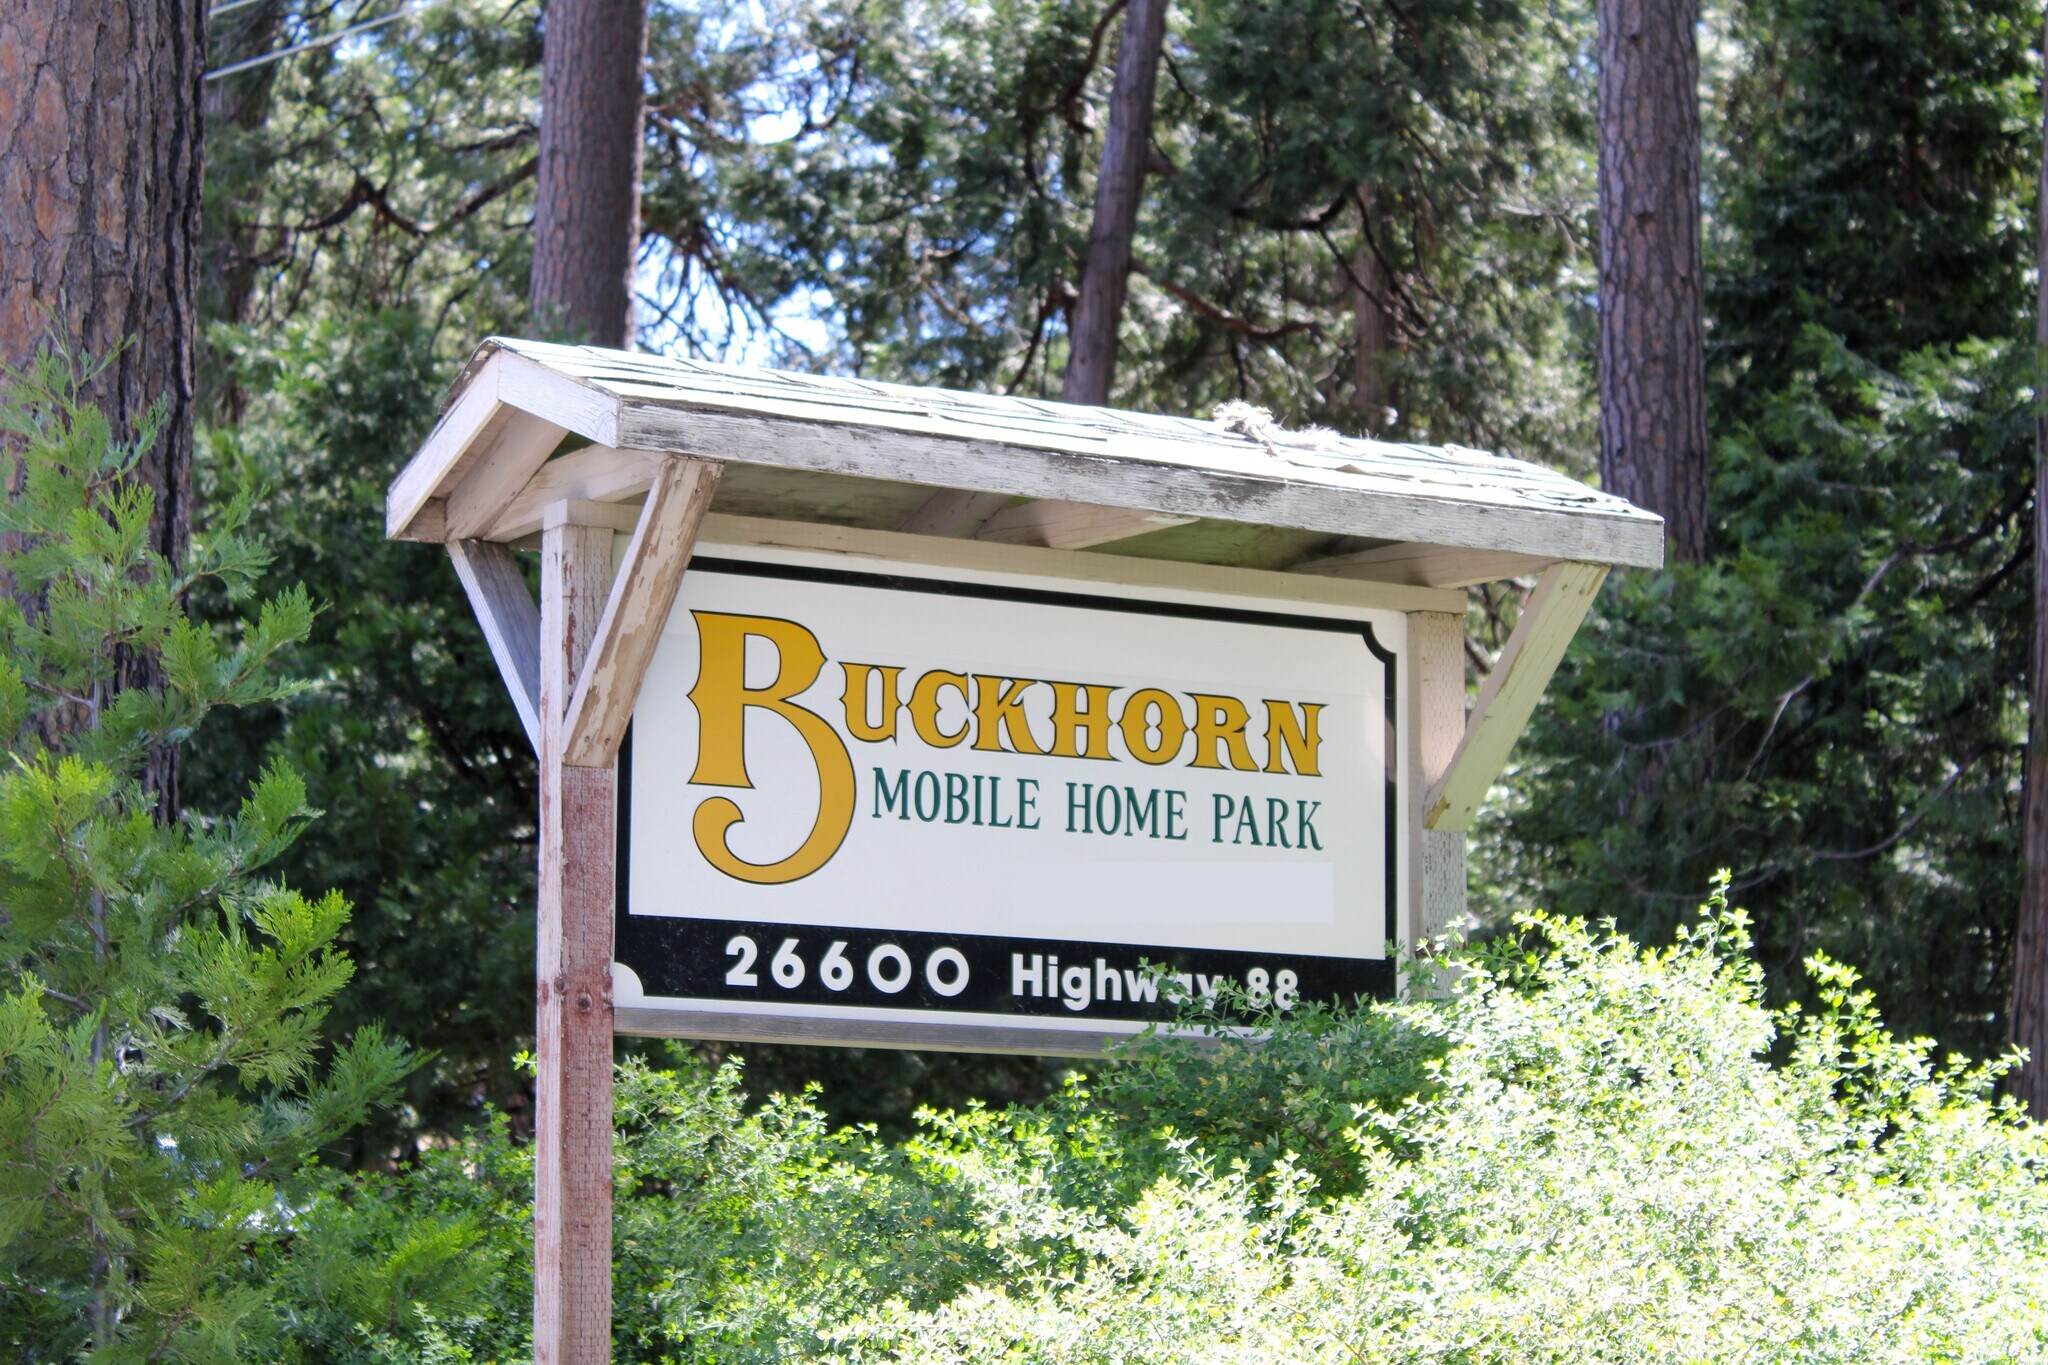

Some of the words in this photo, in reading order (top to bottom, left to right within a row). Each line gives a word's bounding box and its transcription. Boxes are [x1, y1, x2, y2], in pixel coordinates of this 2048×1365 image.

[686, 609, 1328, 885] BUCKHORN
[872, 766, 1042, 830] MOBILE
[1065, 781, 1189, 841] HOME
[1212, 792, 1325, 852] PARK
[725, 935, 971, 998] 26600
[1247, 967, 1300, 1012] 88
